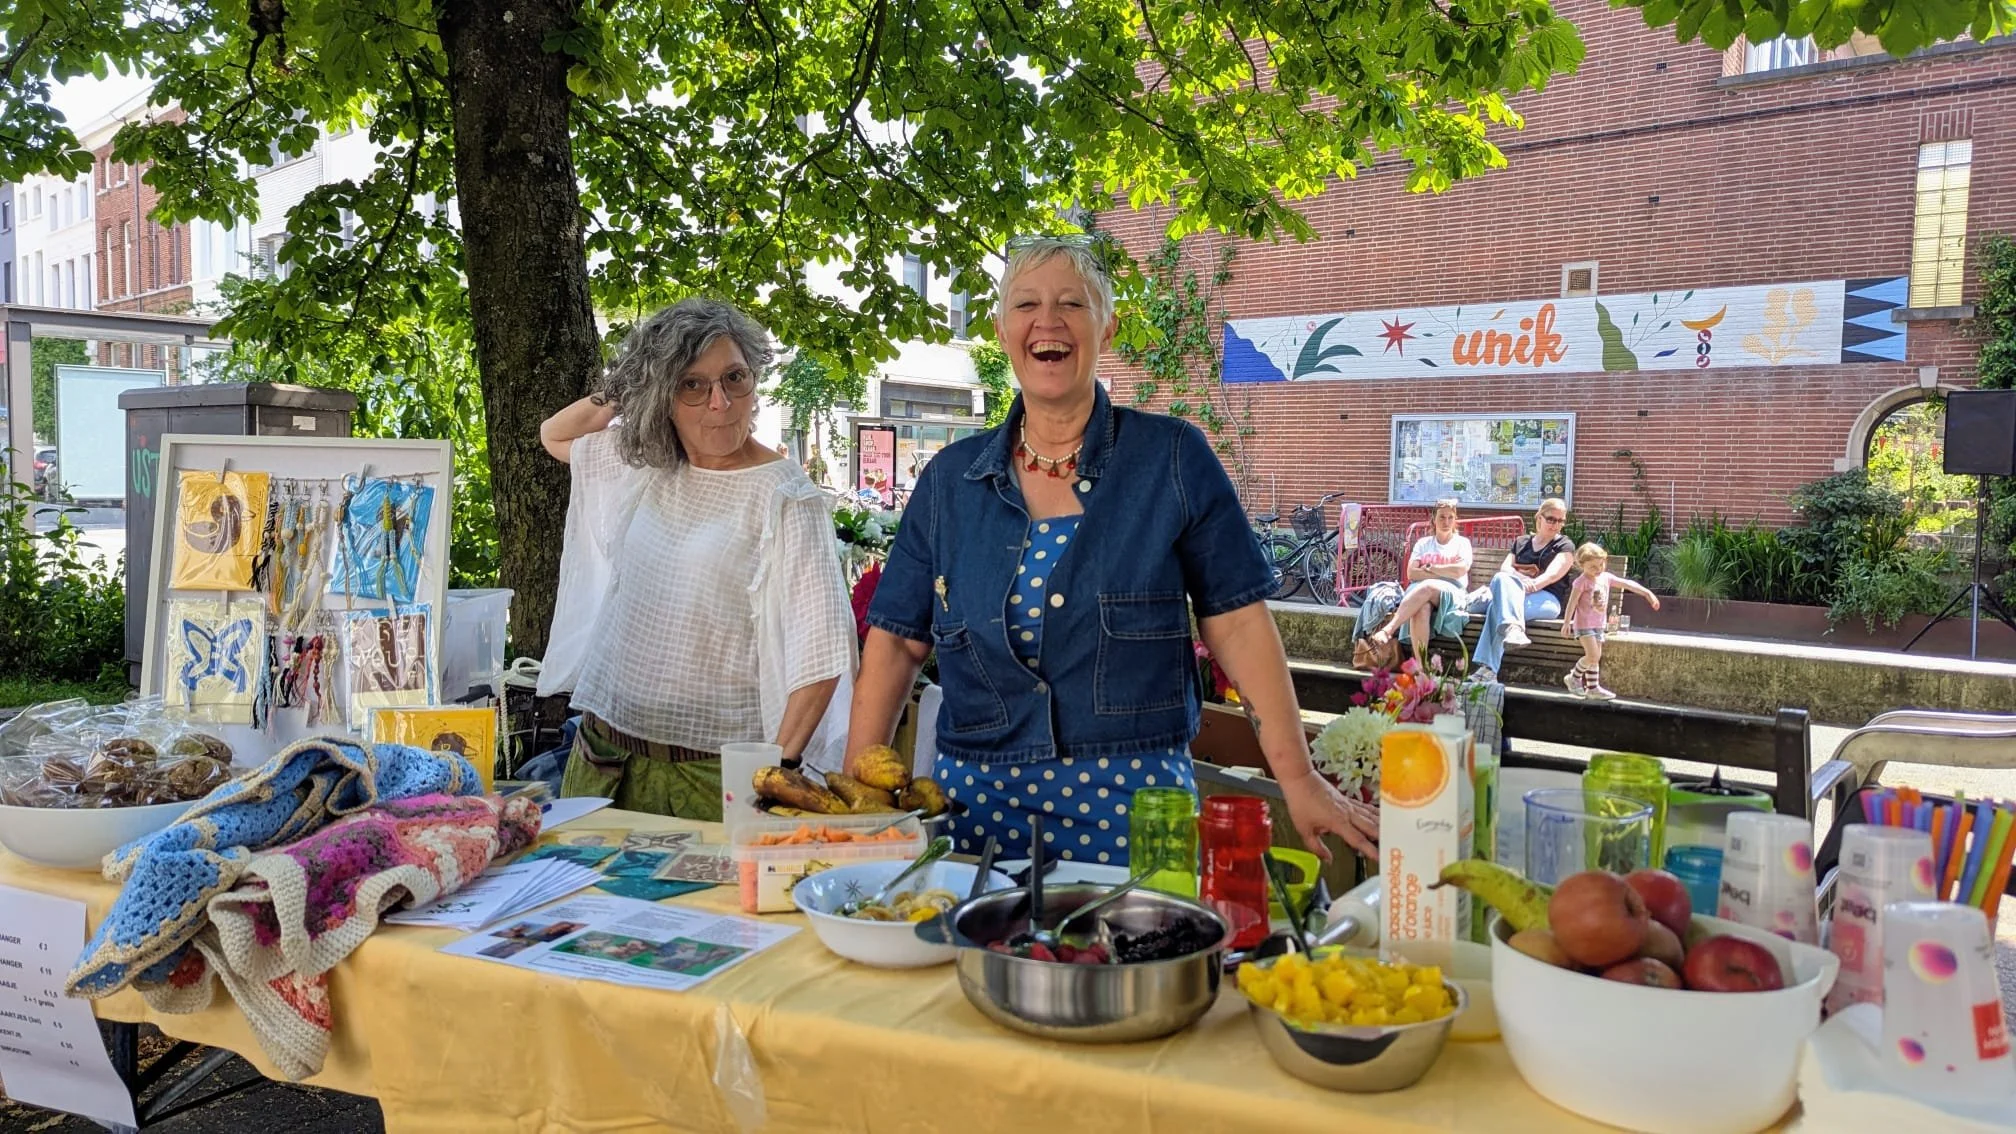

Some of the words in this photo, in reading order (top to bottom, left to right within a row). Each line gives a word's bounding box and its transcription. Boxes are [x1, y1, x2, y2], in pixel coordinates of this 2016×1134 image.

[1452, 303, 1569, 368] unik
[1416, 817, 1453, 832] Everyday
[1388, 848, 1404, 942] aasappelsap
[1402, 873, 1421, 940] d'orange
